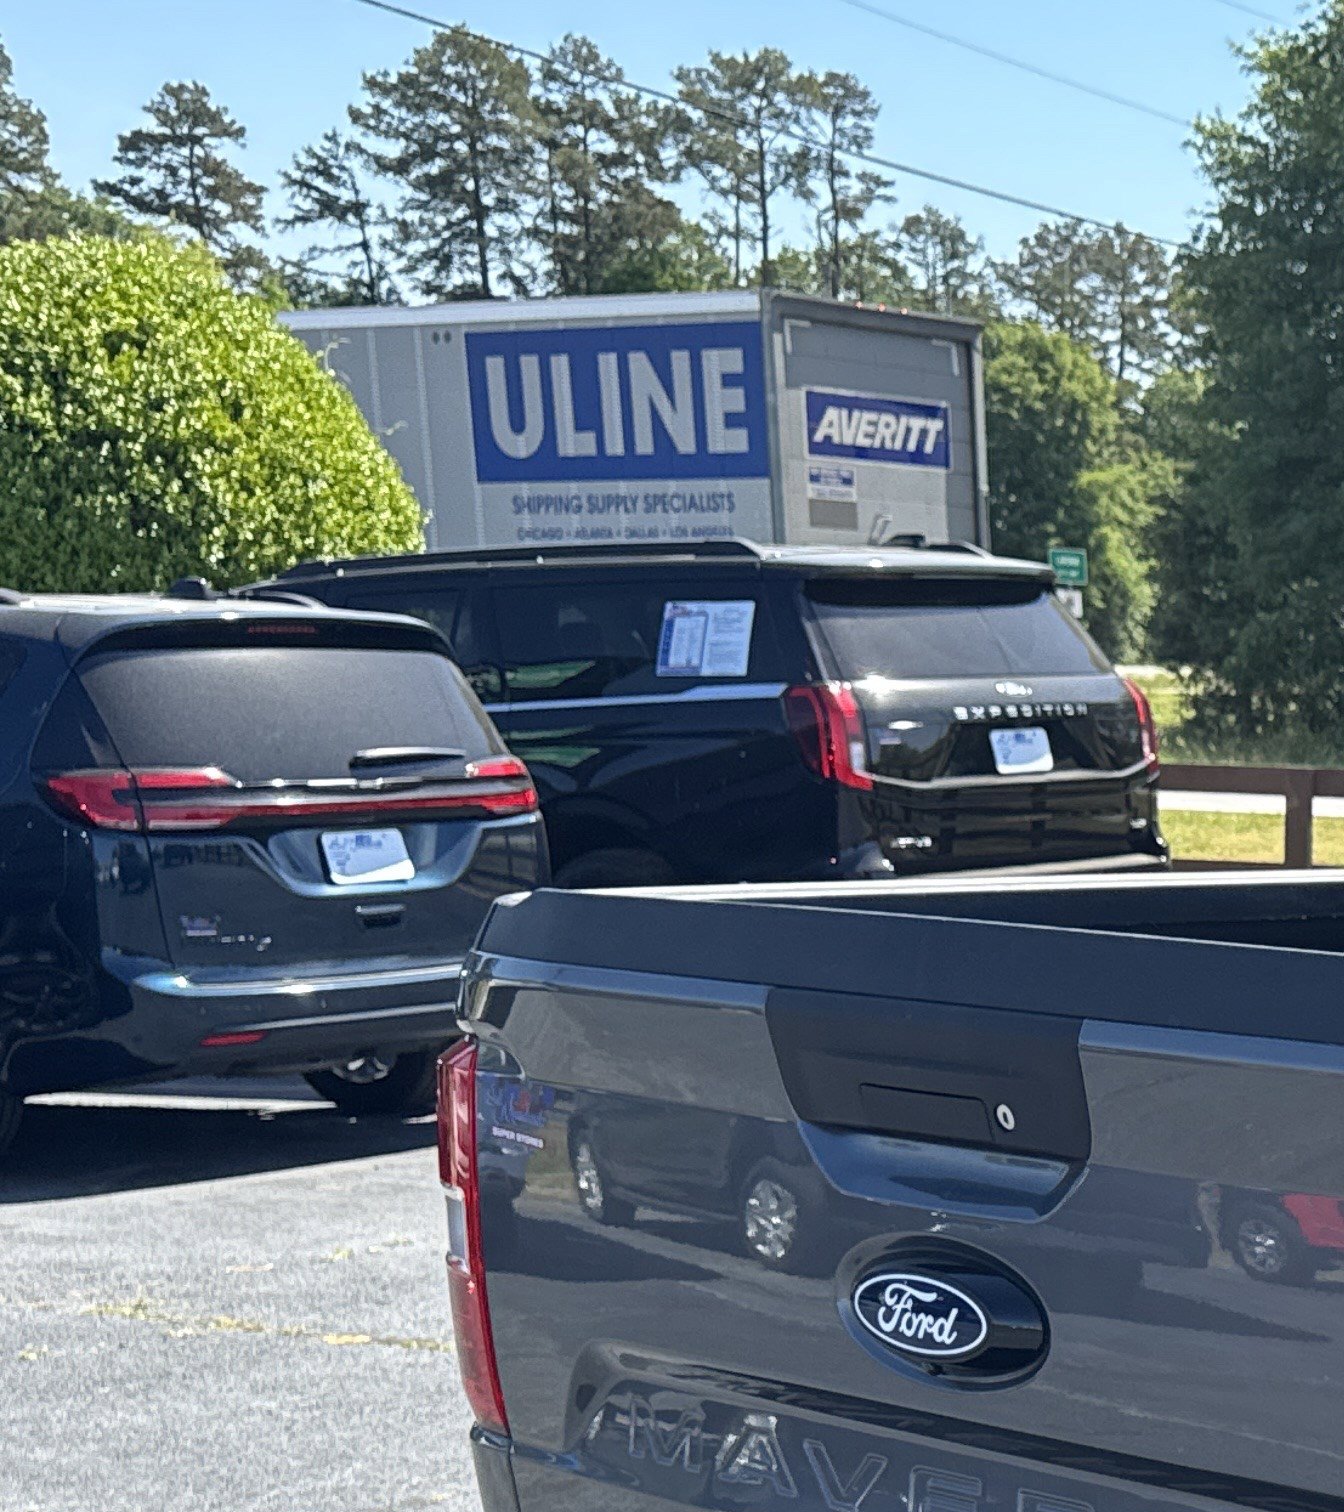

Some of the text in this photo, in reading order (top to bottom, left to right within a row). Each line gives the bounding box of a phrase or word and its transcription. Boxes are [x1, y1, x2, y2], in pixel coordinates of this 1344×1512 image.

[485, 347, 750, 460] ULINE
[812, 405, 944, 454] AVERITT
[512, 491, 736, 515] SHIPPING SUPPLY SPECIALISTS
[953, 702, 1088, 721] EXPEDITION
[878, 1282, 959, 1345] Ford
